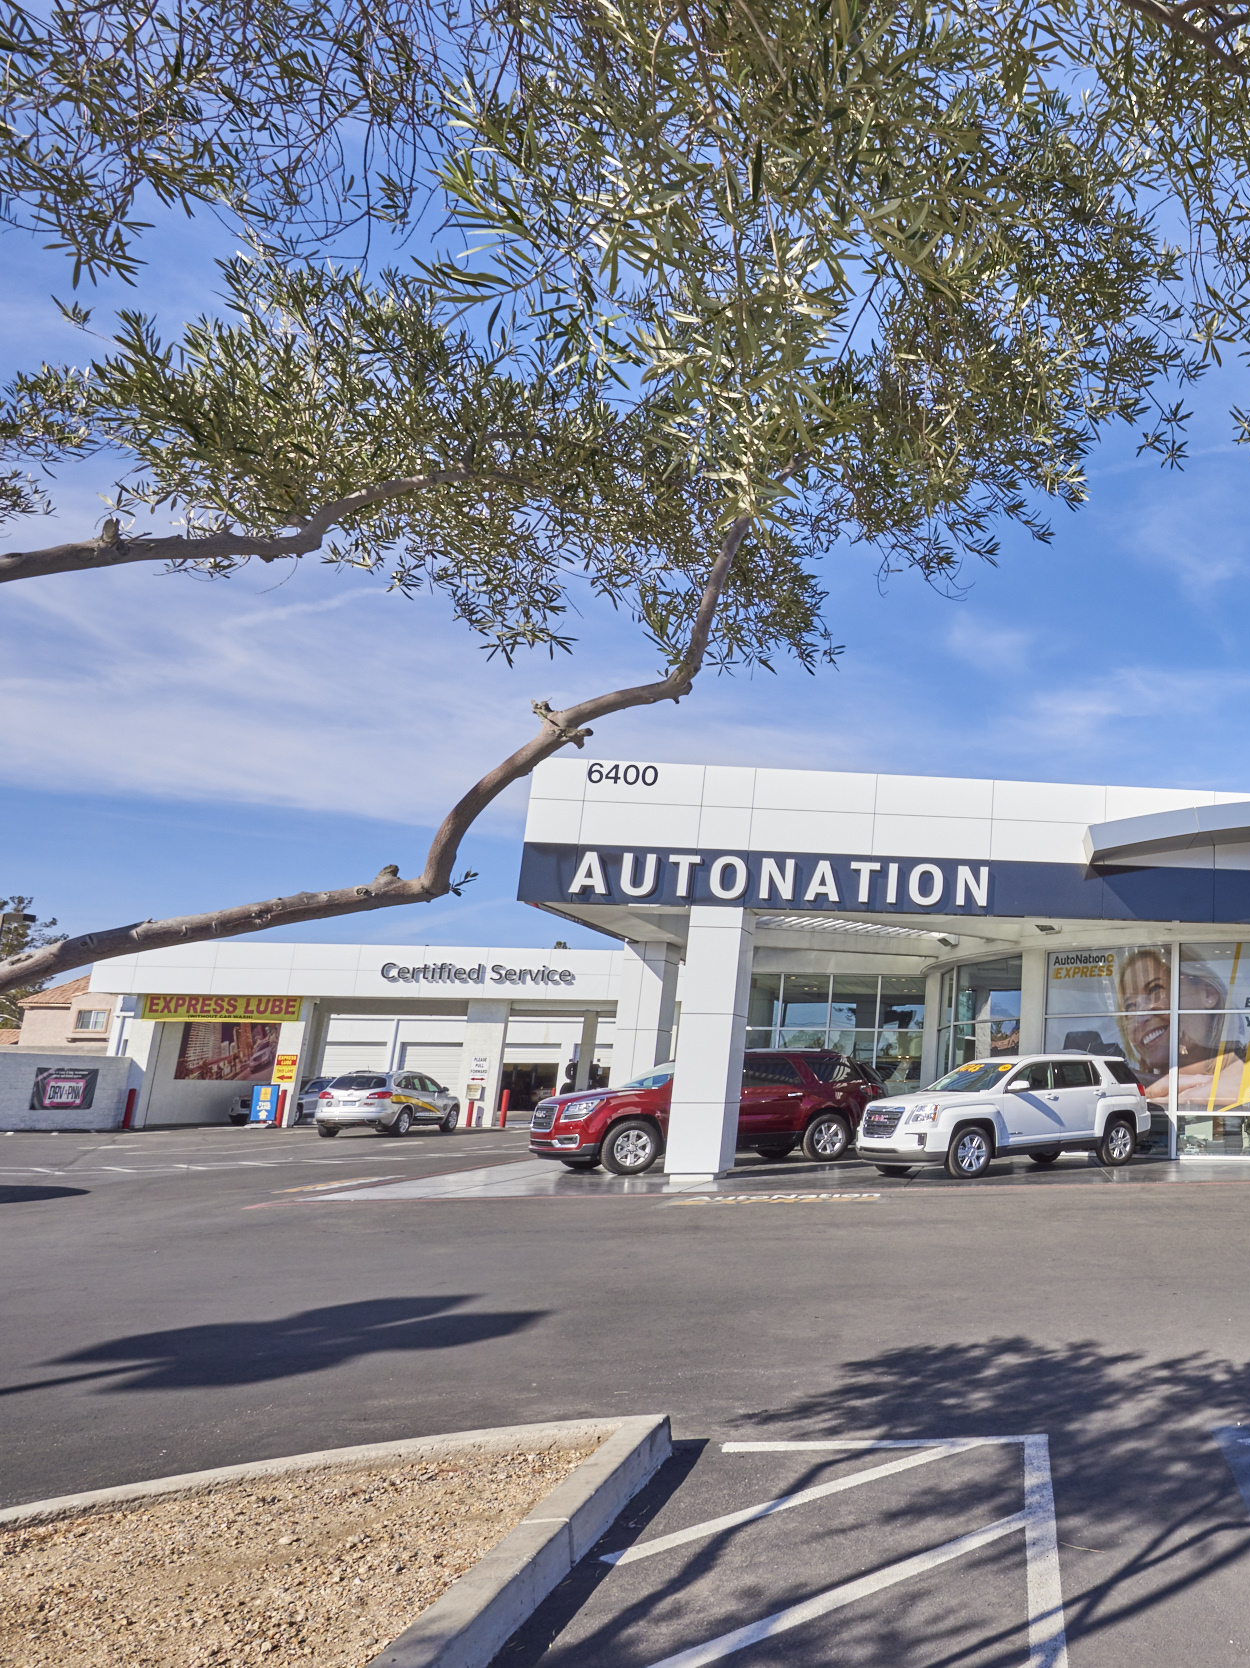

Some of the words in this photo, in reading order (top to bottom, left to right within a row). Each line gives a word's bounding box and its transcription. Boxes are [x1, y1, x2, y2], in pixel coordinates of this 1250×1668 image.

[588, 762, 659, 786] 6400
[568, 850, 990, 908] AUTONATION
[1053, 953, 1106, 966] AutoNation
[380, 962, 485, 984] Certified
[489, 964, 575, 985] Service
[1052, 964, 1115, 980] EXPRESS
[148, 996, 238, 1014] EXPRESS
[243, 997, 298, 1015] LUBE
[684, 1193, 881, 1201] AutoNation
